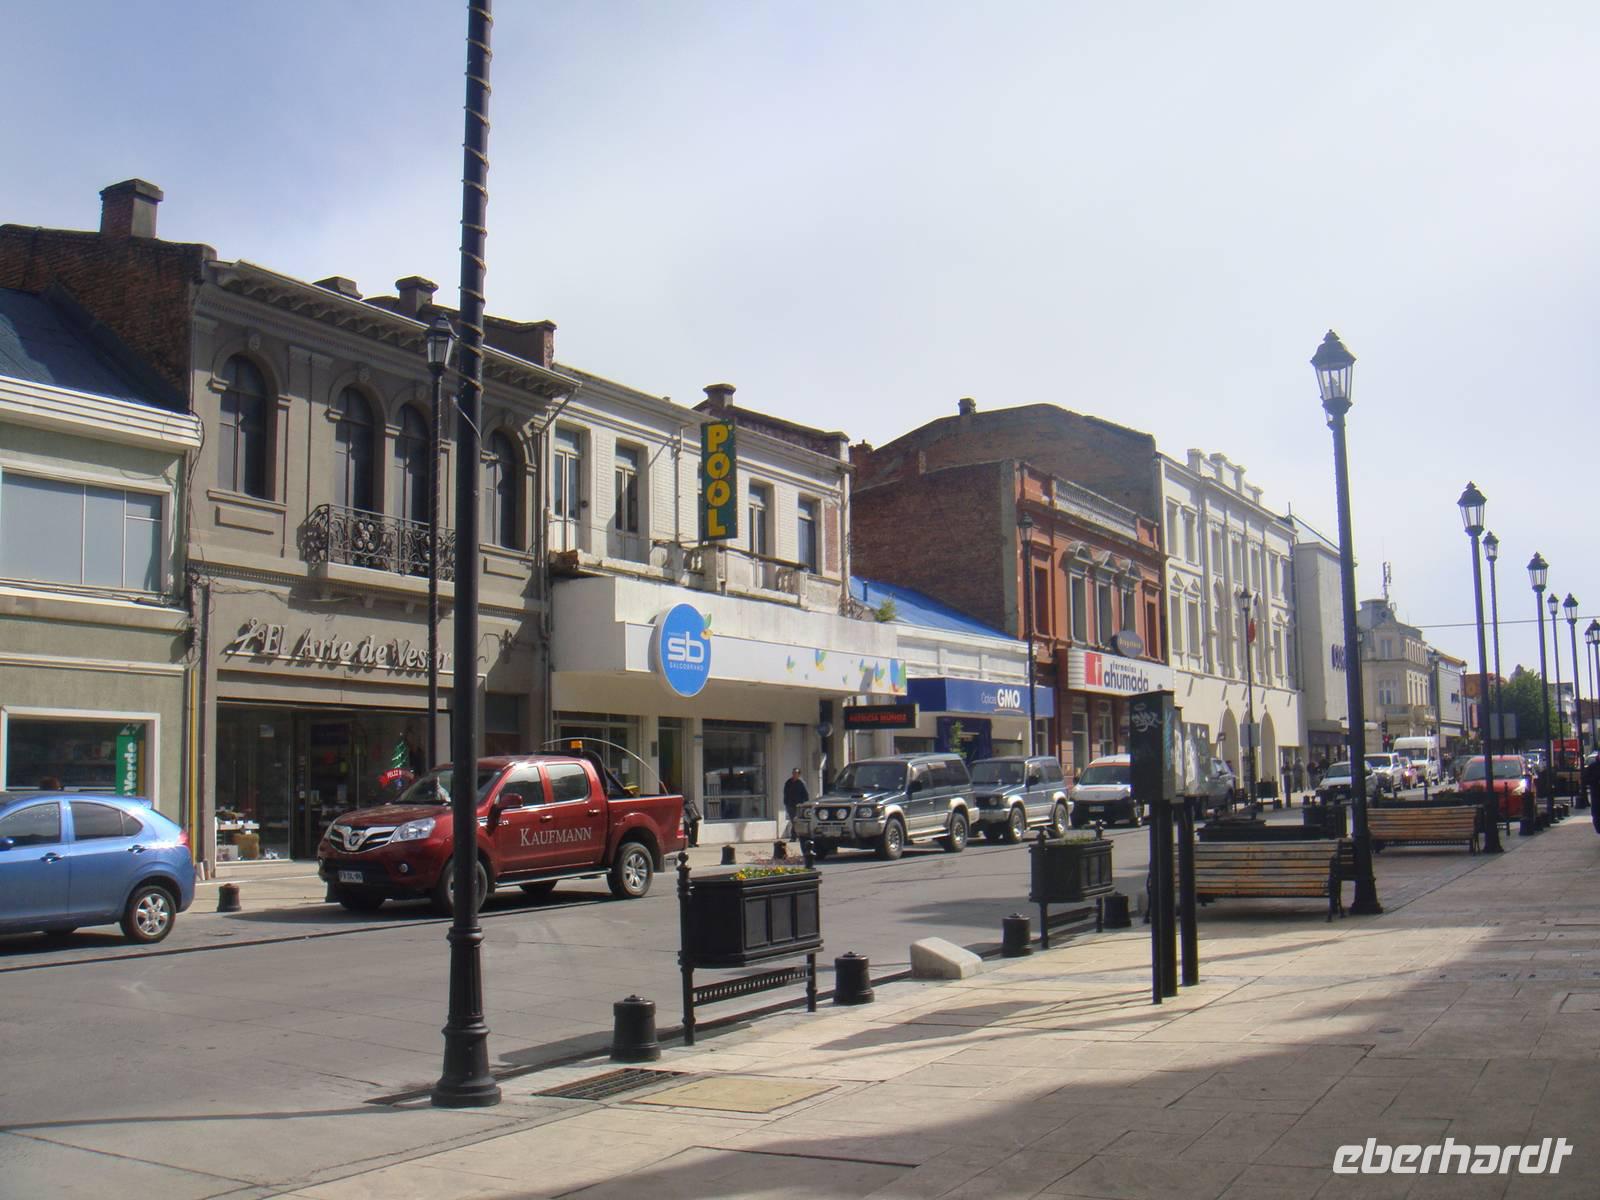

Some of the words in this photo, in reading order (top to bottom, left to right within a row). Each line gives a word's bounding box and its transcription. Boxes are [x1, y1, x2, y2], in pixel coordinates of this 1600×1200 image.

[706, 424, 731, 537] POOL
[264, 623, 287, 654] El
[298, 630, 350, 660] Arte
[360, 634, 387, 664] de
[397, 639, 452, 669] Vesir
[667, 631, 705, 664] sb
[1103, 667, 1149, 692] ahumada
[997, 688, 1020, 708] GMO
[520, 827, 592, 847] KAUFMANN
